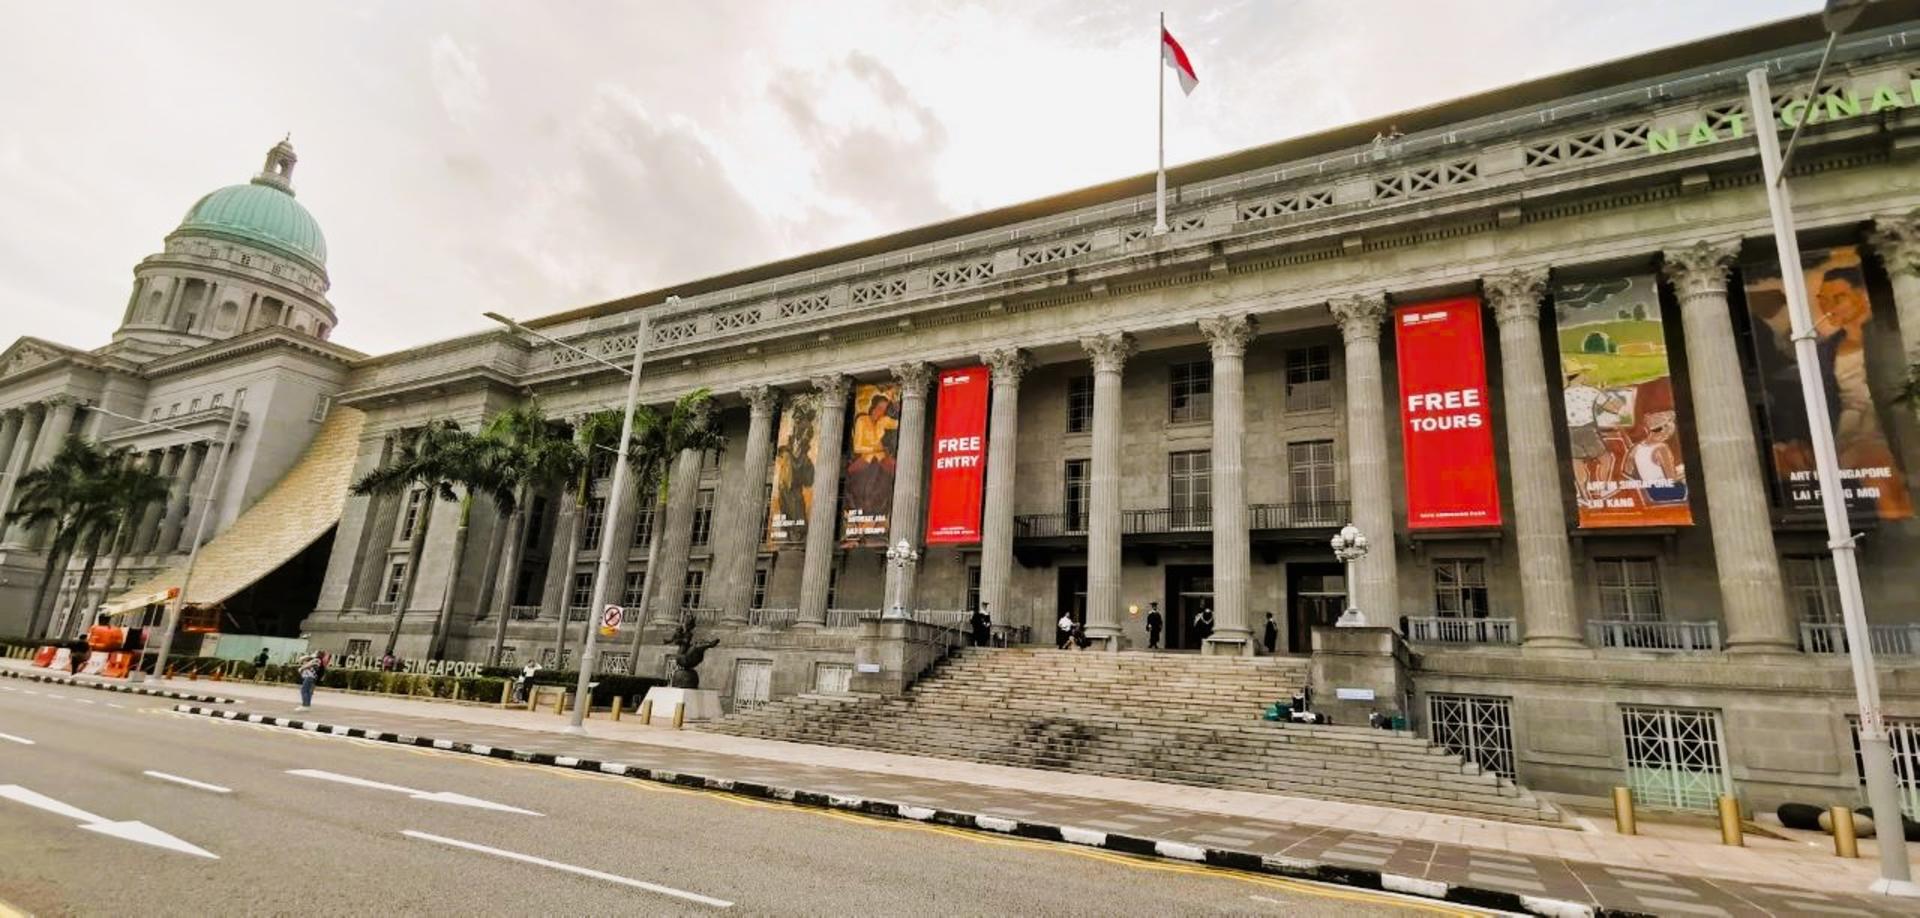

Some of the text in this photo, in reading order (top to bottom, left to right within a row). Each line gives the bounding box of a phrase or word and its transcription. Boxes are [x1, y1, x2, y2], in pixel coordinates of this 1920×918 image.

[1407, 388, 1481, 413] FREE
[1410, 412, 1483, 433] TOURS
[938, 436, 981, 454] FREE
[936, 455, 980, 469] ENTRY
[1790, 470, 1812, 482] ART
[1792, 490, 1812, 501] LAI
[1857, 486, 1881, 499] MOI
[403, 658, 484, 678] SINGAPORE
